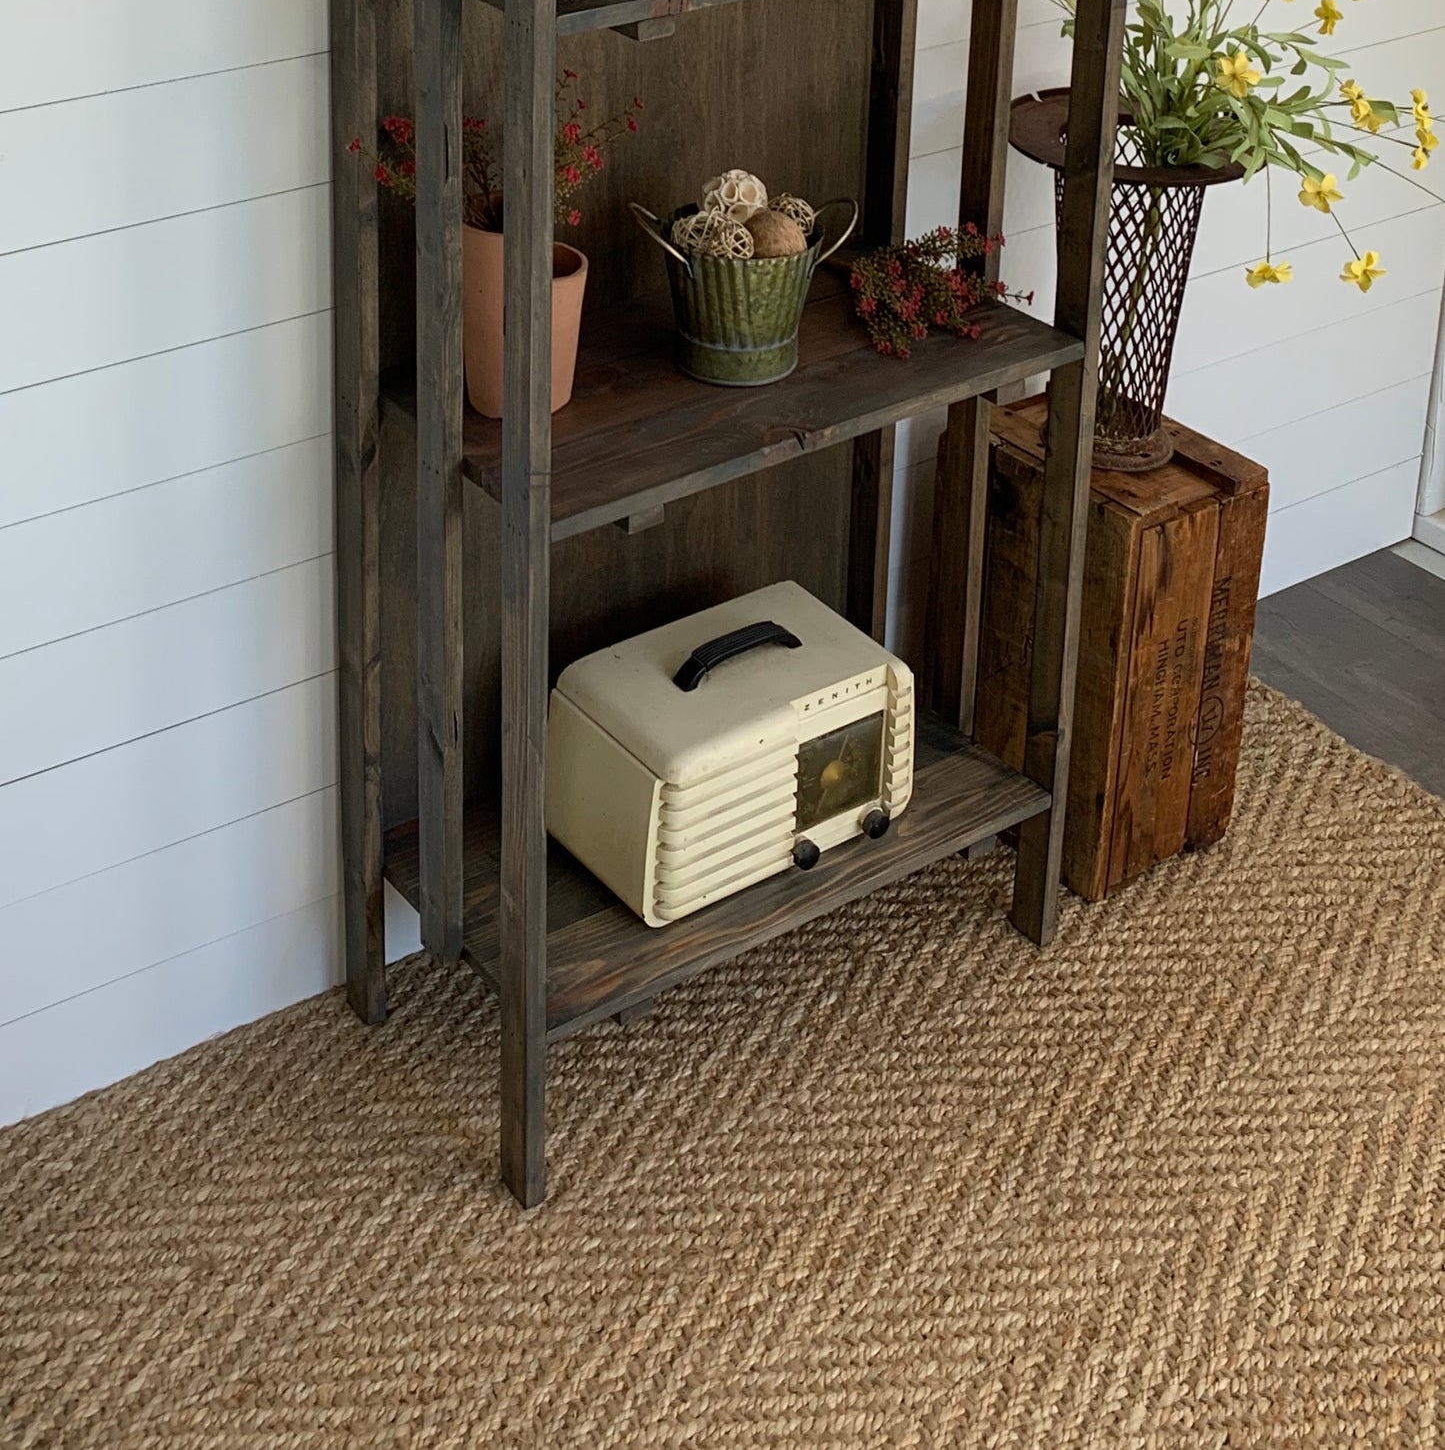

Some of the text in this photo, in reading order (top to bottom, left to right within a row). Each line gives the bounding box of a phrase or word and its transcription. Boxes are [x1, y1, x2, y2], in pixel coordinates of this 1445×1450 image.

[1203, 576, 1232, 690] MERRIMAN
[804, 678, 872, 711] ZENITH
[1161, 665, 1182, 780] CORPORATION
